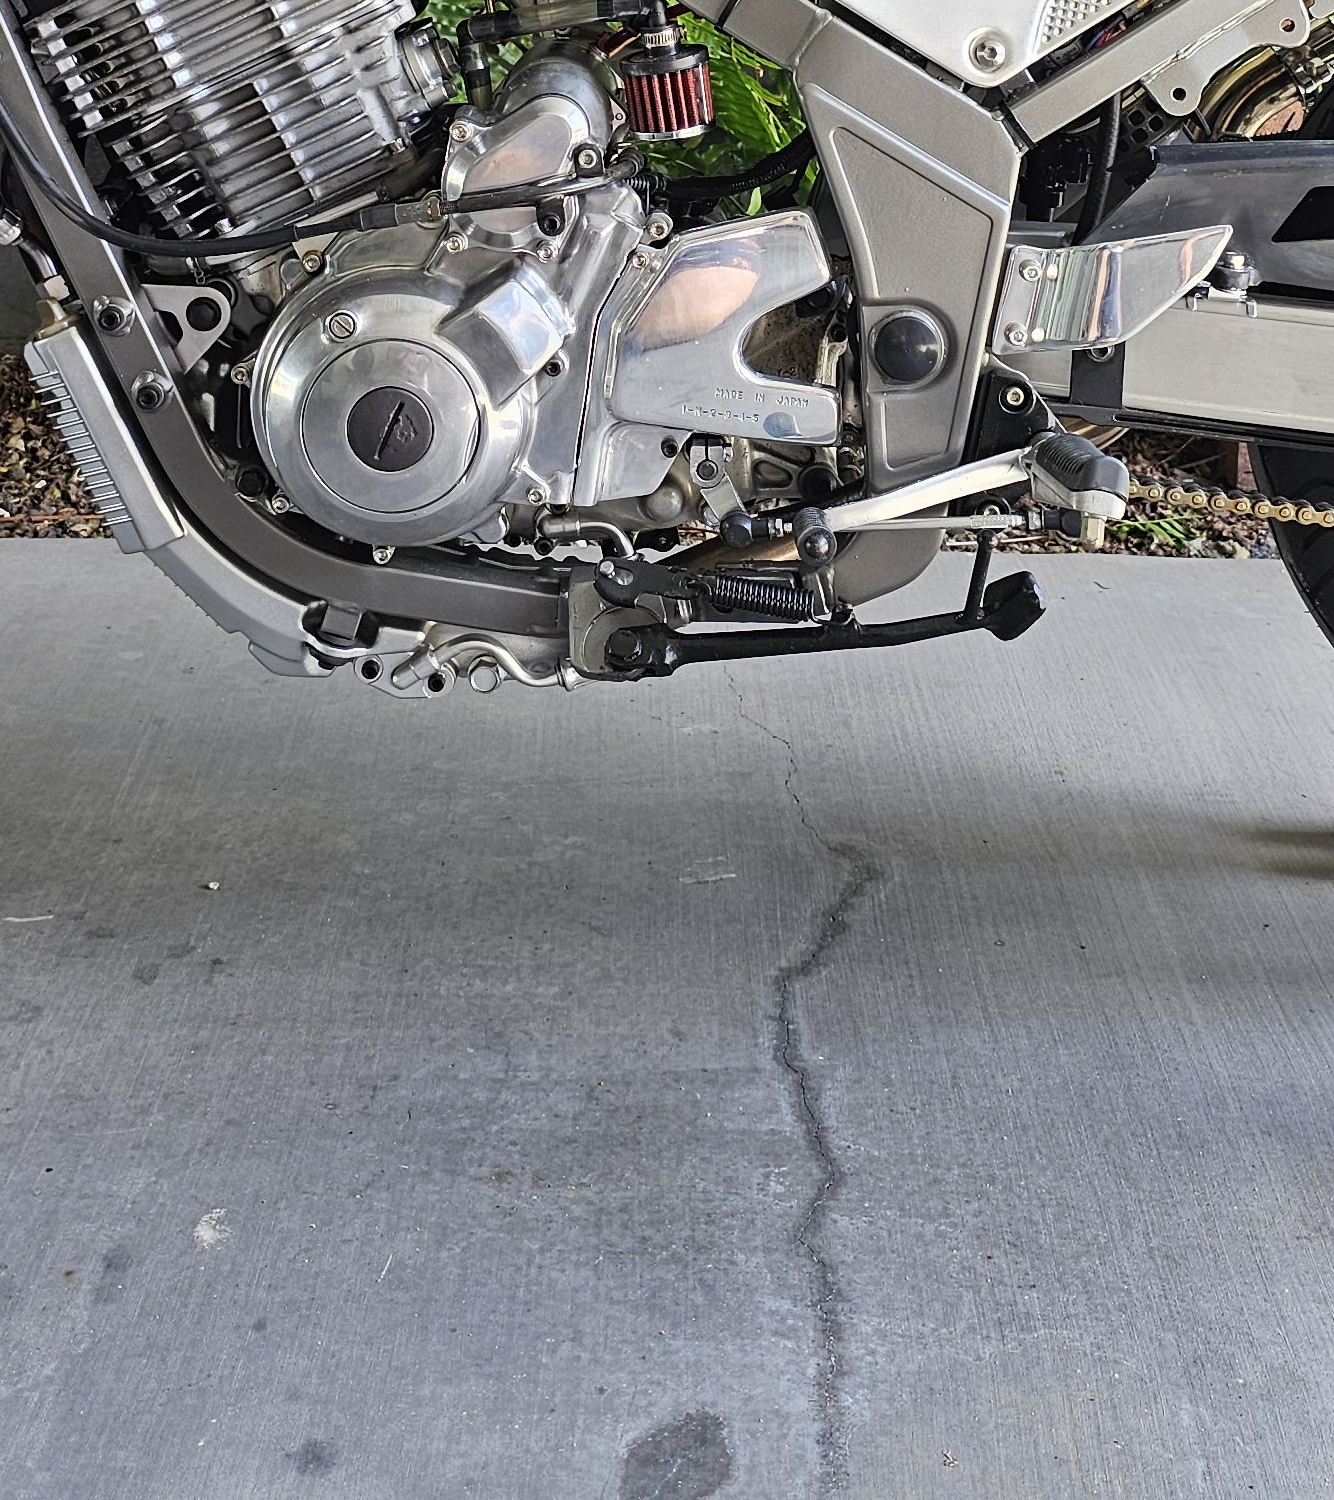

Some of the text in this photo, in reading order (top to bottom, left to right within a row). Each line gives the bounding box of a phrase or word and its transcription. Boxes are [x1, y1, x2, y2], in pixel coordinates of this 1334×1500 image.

[715, 388, 809, 407] MADE IN JAPAN
